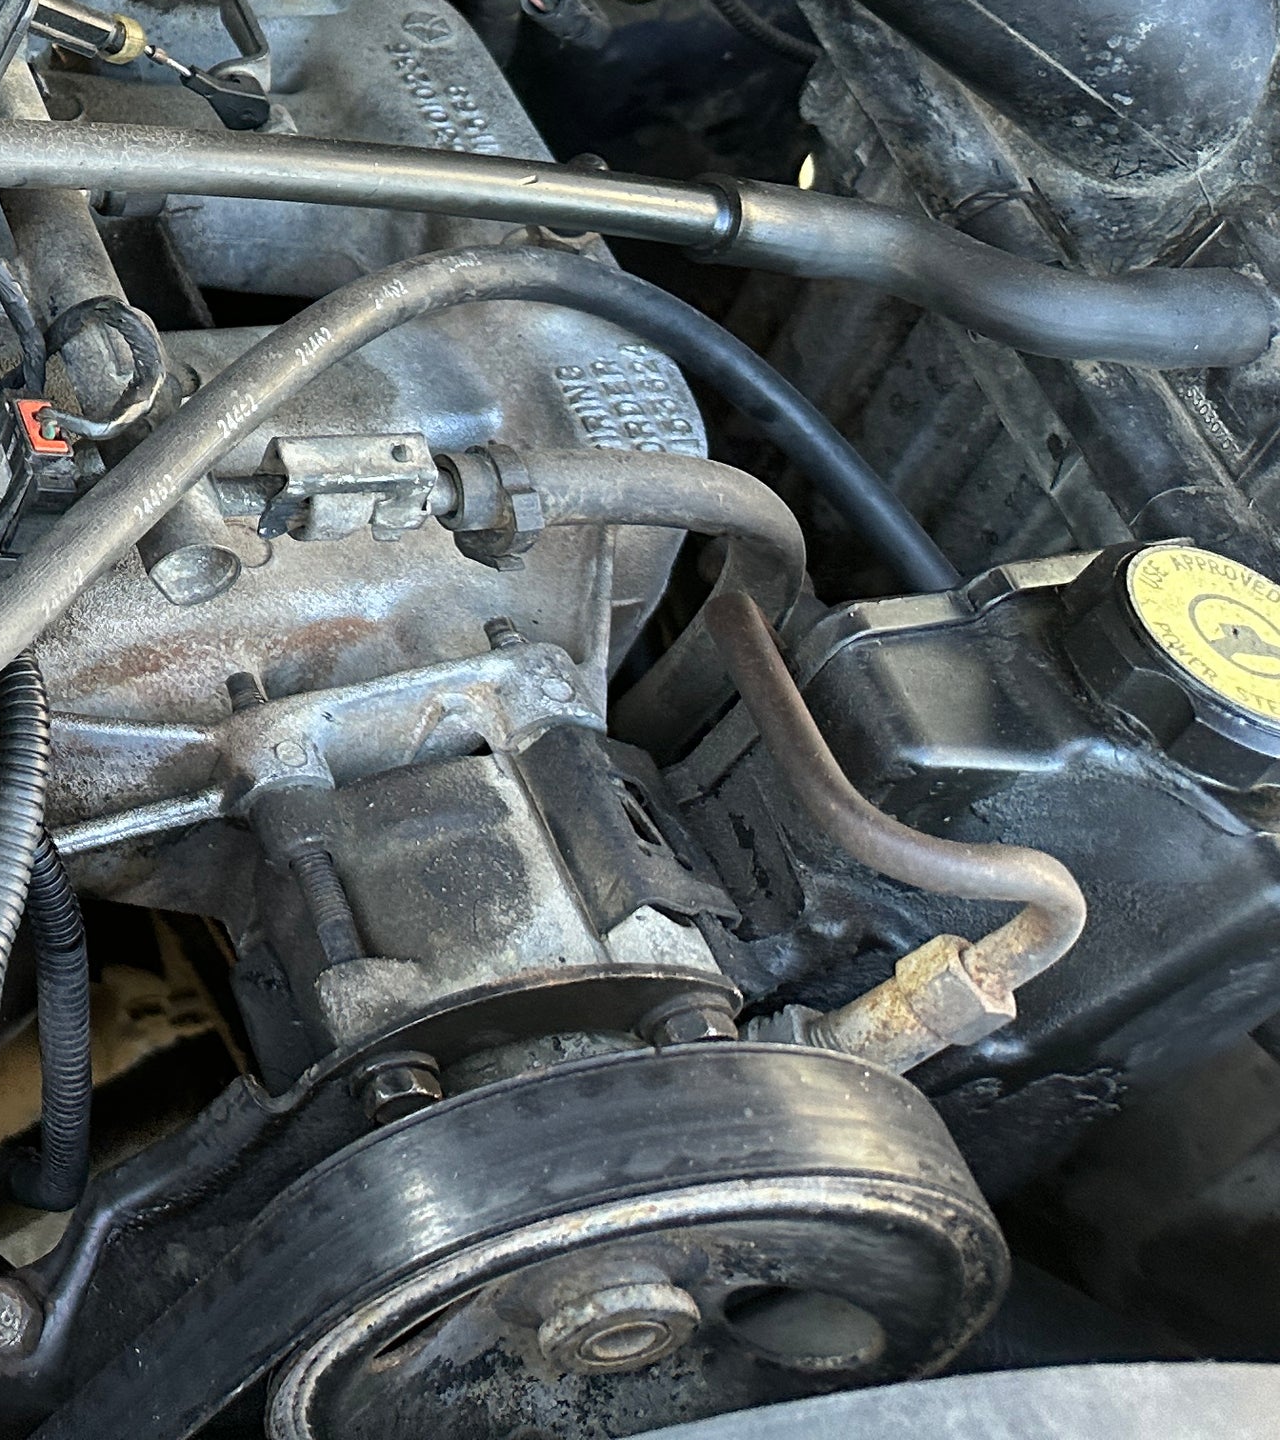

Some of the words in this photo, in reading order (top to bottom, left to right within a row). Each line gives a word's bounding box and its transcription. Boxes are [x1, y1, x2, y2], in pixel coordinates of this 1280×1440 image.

[1138, 559, 1169, 591] USE
[1169, 553, 1280, 604] APPROVED
[1153, 620, 1219, 682] POWER
